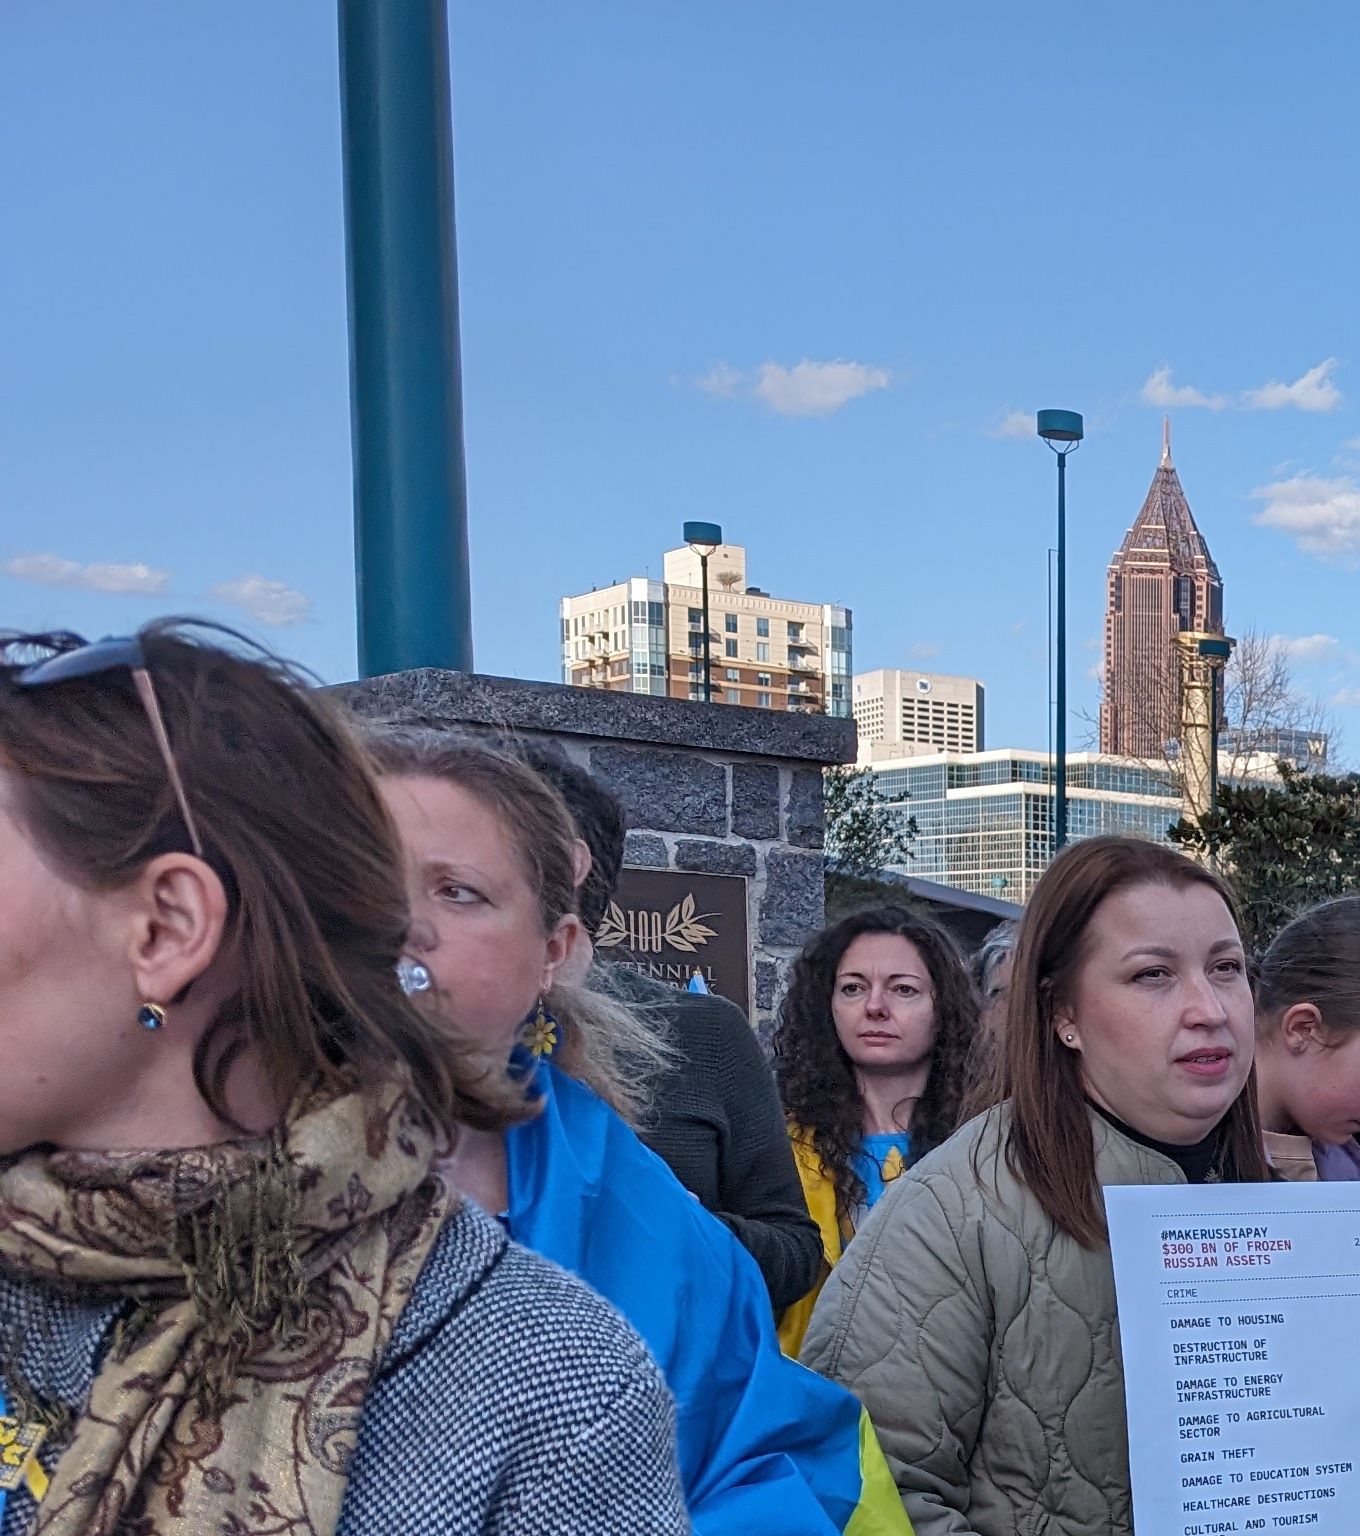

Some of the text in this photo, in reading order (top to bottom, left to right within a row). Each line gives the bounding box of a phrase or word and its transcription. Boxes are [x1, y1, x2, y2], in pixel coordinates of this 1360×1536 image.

[628, 910, 662, 952] 100
[1161, 1227, 1267, 1241] #MAKERUSSIAPAY
[1162, 1240, 1292, 1255] $300 BN OF FROZEN
[1164, 1254, 1271, 1268] RUSSIAN ASSETS
[1167, 1288, 1197, 1298] CRIME
[1171, 1314, 1284, 1329] DAMAGE TO HOUSING
[1173, 1339, 1266, 1354] DESTRUCTION OF
[1174, 1351, 1268, 1366] INFRASTRUCTURE
[1176, 1373, 1283, 1390] DAMAGE TO ENERGY
[1177, 1386, 1271, 1403] INFRASTRUCTURE
[1179, 1405, 1325, 1427] DAMAGE TO AGRICULTURAL
[1179, 1427, 1220, 1439] SECTOR
[1180, 1447, 1255, 1463] GRAIN THEFT
[1182, 1463, 1352, 1488] DAMAGE TO EDUCATION SYSTEM
[1183, 1487, 1336, 1512] HEALTHCARE DESTRUCTIONS
[1184, 1513, 1318, 1536] CULTURAL AND TOURISM
